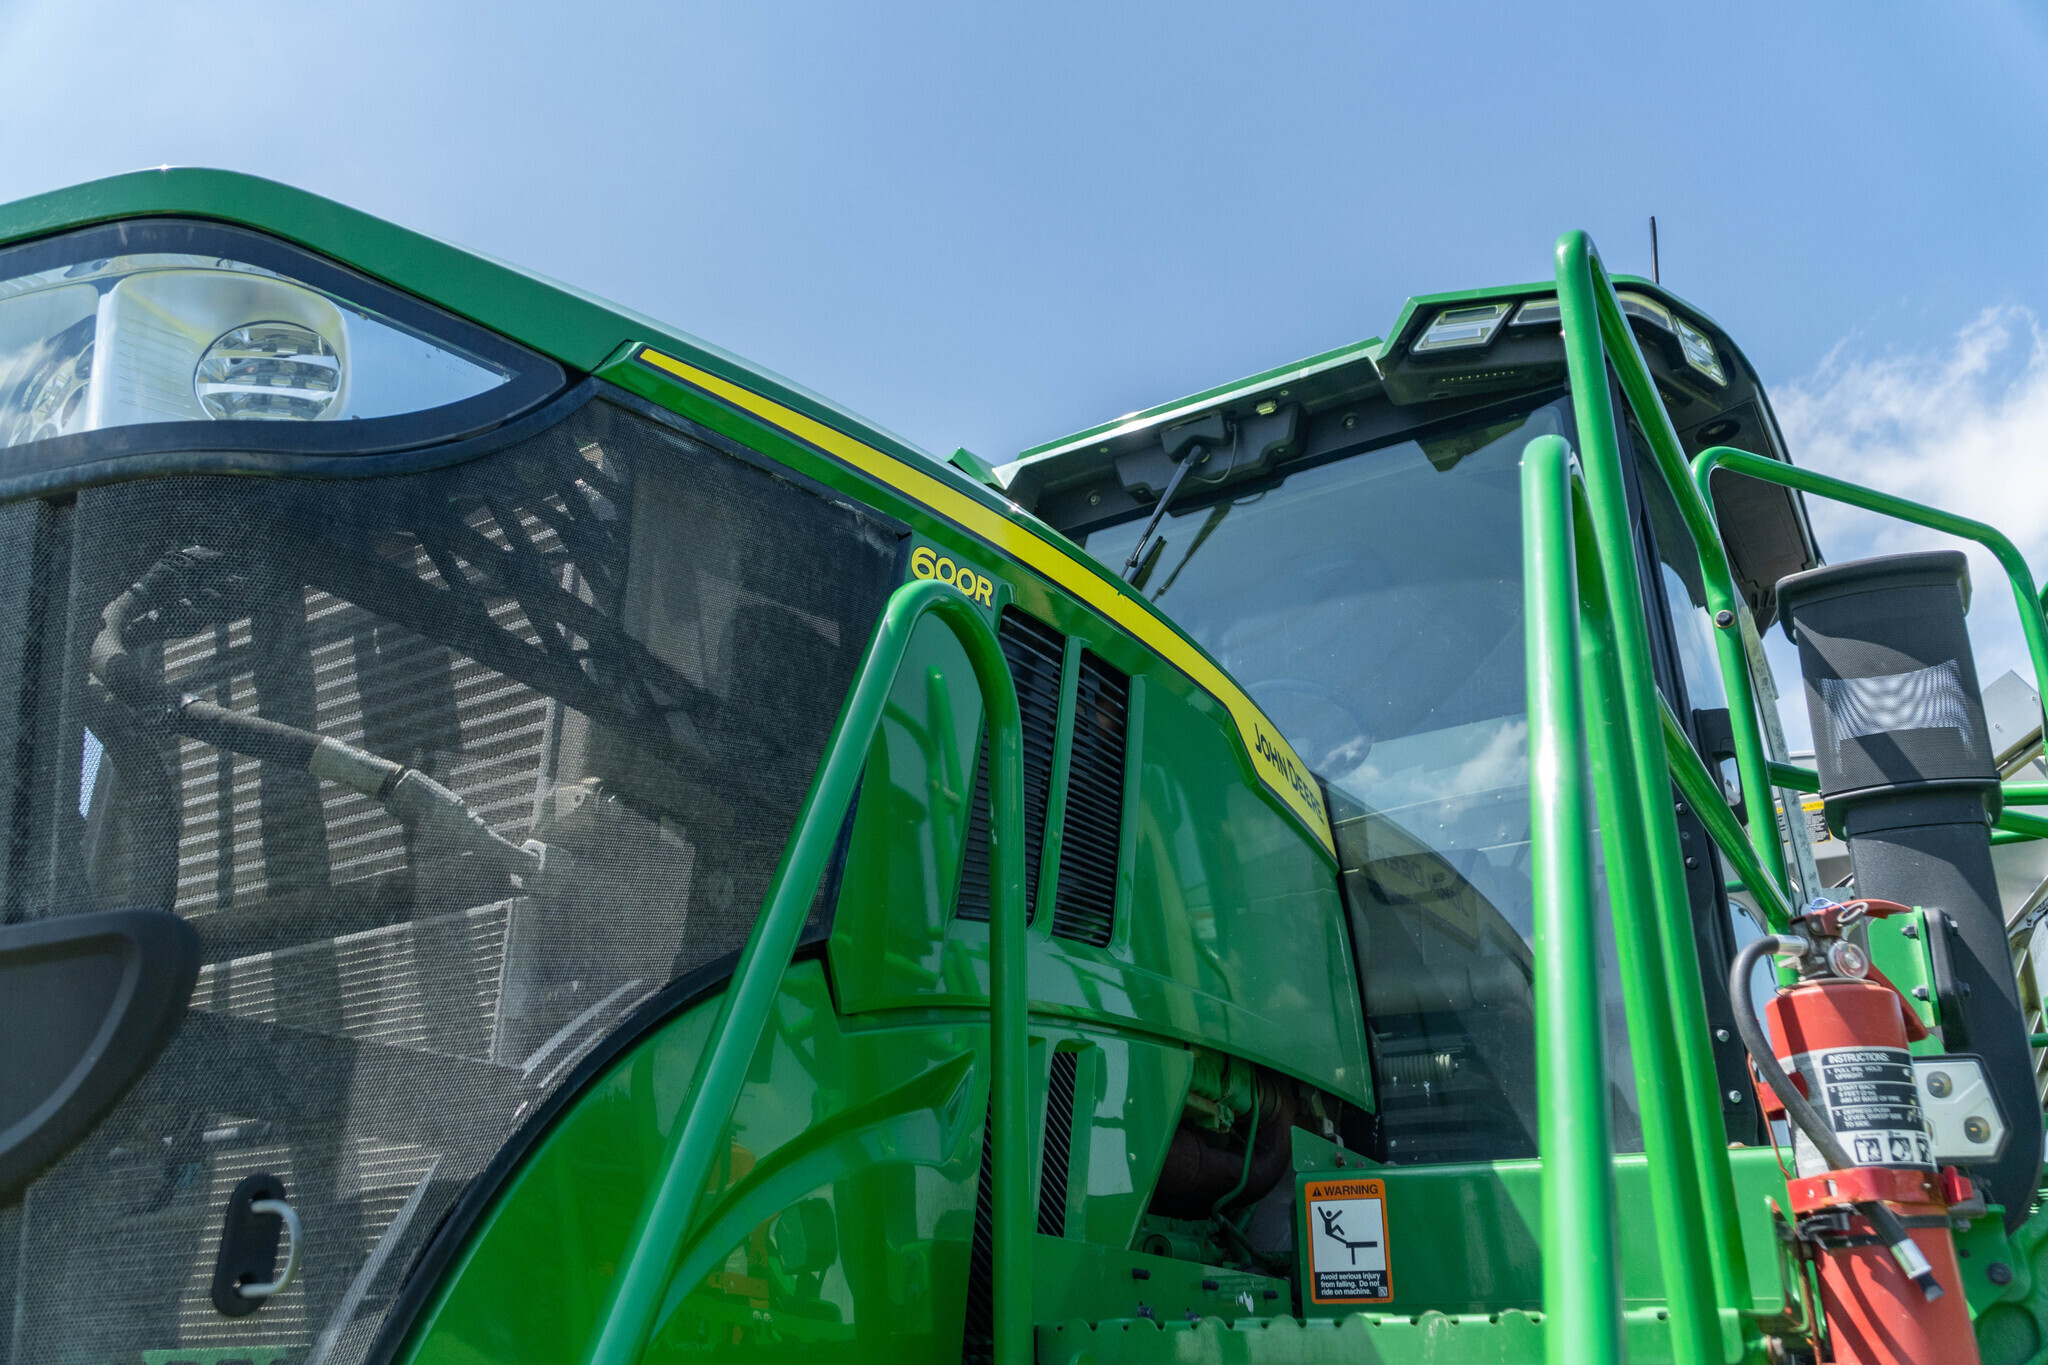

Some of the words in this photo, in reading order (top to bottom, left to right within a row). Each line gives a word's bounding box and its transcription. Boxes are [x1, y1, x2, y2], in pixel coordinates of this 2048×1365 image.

[911, 546, 994, 609] 600R
[1254, 723, 1289, 781] JOHN
[1287, 758, 1325, 825] DEERE
[1827, 1052, 1890, 1064] INSTRUCTIONS:
[1833, 1066, 1850, 1074] PULL
[1324, 1184, 1378, 1196] WARNING
[1362, 1272, 1380, 1281] injury
[1336, 1280, 1356, 1289] falling.
